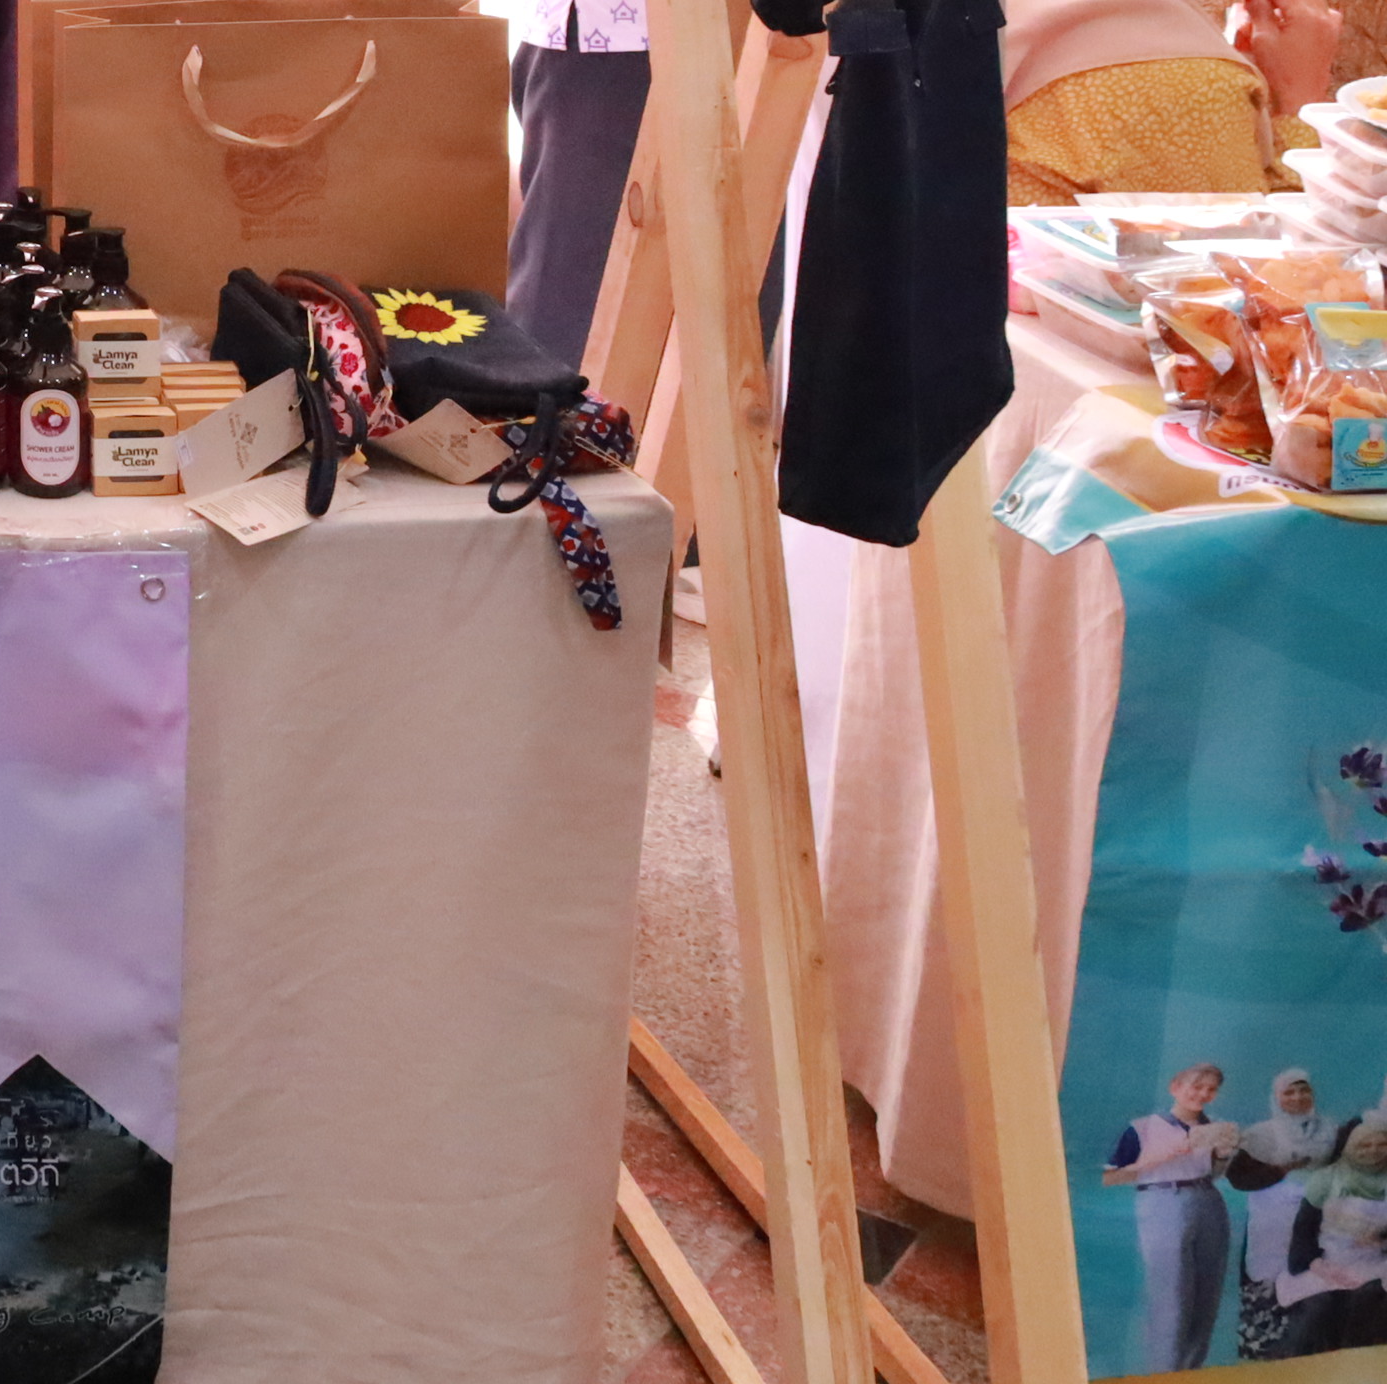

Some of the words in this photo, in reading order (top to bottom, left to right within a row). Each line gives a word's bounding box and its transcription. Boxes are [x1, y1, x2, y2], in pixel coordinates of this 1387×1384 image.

[98, 349, 138, 361] Lamya
[102, 360, 135, 370] Clean
[117, 446, 158, 458] Lamya
[122, 456, 155, 467] Clean
